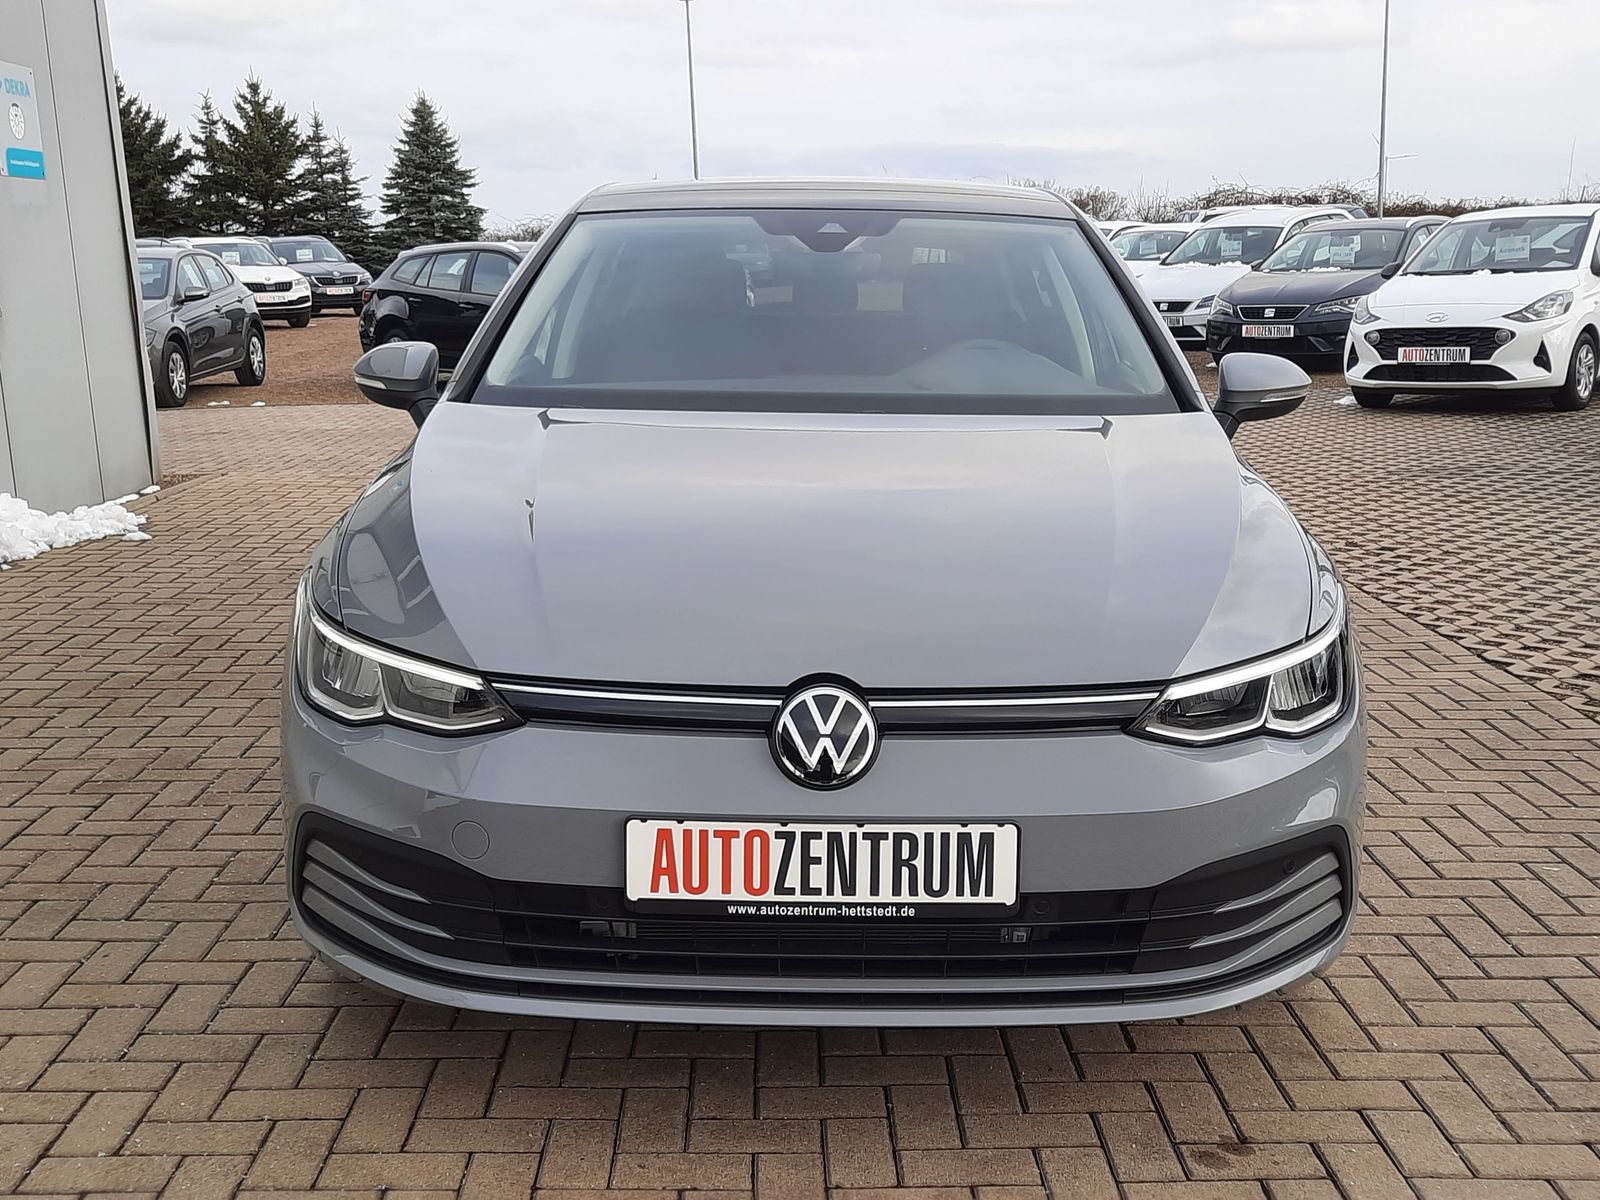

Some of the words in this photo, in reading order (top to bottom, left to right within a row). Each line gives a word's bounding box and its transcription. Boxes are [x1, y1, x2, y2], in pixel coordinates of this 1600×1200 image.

[4, 78, 31, 97] DEKRA
[1245, 326, 1291, 337] AUTOZENTRUM
[1402, 348, 1466, 362] AUTOZENTRUM
[649, 827, 995, 899] AUTOZENTRUM
[727, 903, 916, 918] www.autozentrum-hettstedt.de
